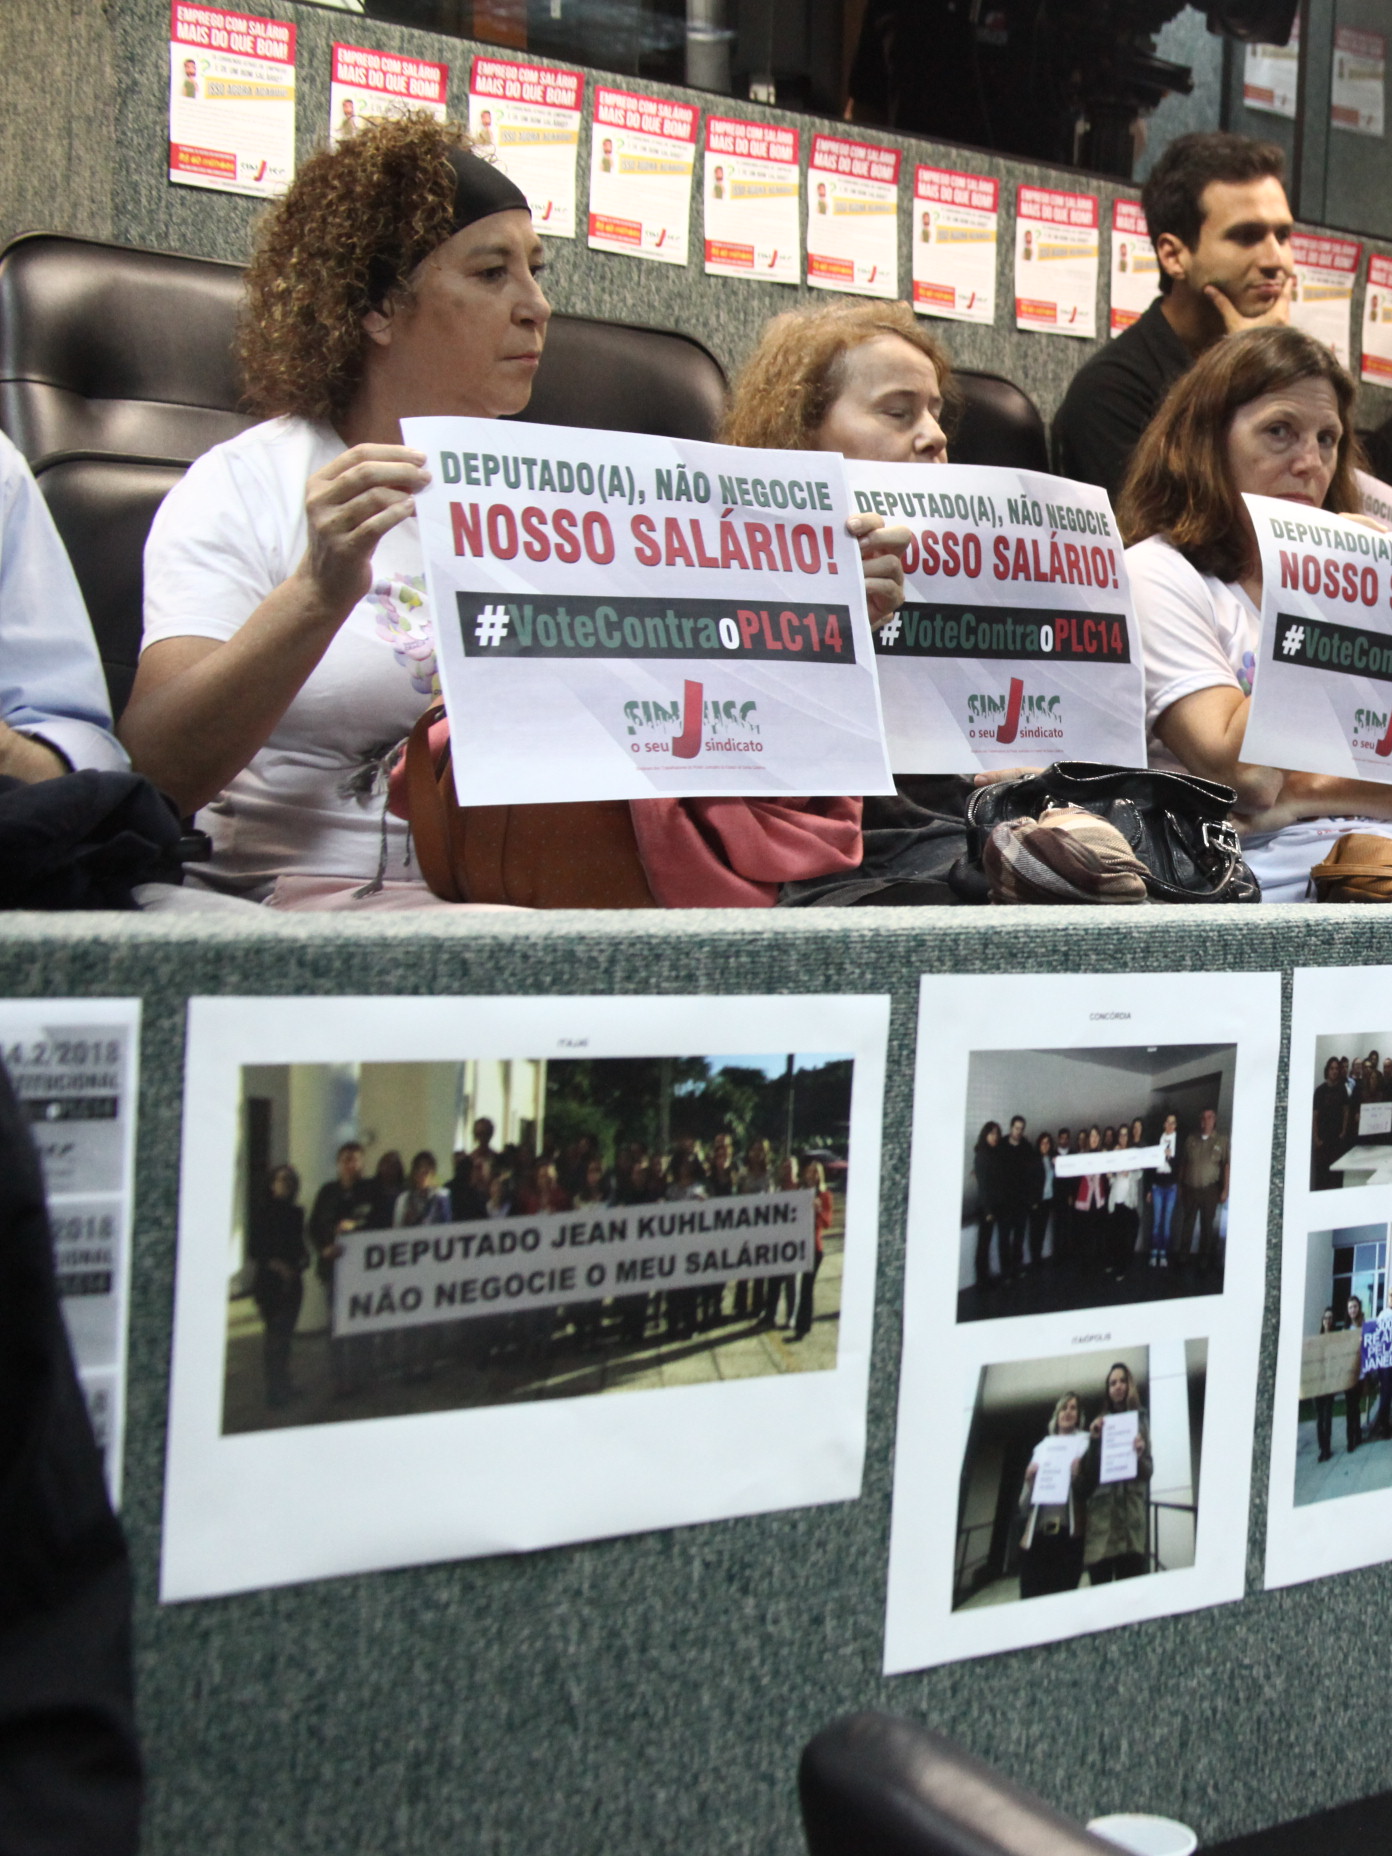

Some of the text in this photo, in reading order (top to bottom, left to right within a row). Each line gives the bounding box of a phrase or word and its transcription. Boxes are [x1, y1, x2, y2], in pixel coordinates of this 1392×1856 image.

[177, 21, 288, 60] MAIS DO QUE BOM!
[337, 63, 440, 99] MAIS DO QUE BOM!
[476, 76, 576, 107] MAIS DO QUE BOM!
[440, 450, 834, 512] DEPUTADO(A), NÃO NEGOCIE
[854, 490, 1110, 537] DEPUTADO(A), NÃO NEGOCIE
[450, 501, 839, 575] NOSSO SALÁRIO!
[902, 529, 1119, 589] OSSO SALÁRIO!
[1279, 550, 1379, 607] NOSSO
[474, 604, 843, 653] #VoteContraoPLC14
[879, 611, 1123, 653] #VoteContraoPLC14
[631, 738, 763, 753] o seu sindicato
[969, 726, 1064, 739] o seu sindicato
[1360, 740, 1375, 750] seu
[364, 1203, 798, 1271] DEPUTADO JEAN KUHLMANN:
[348, 1240, 807, 1320] NÃO NEGOCIE O MEU SALÁRIO!
